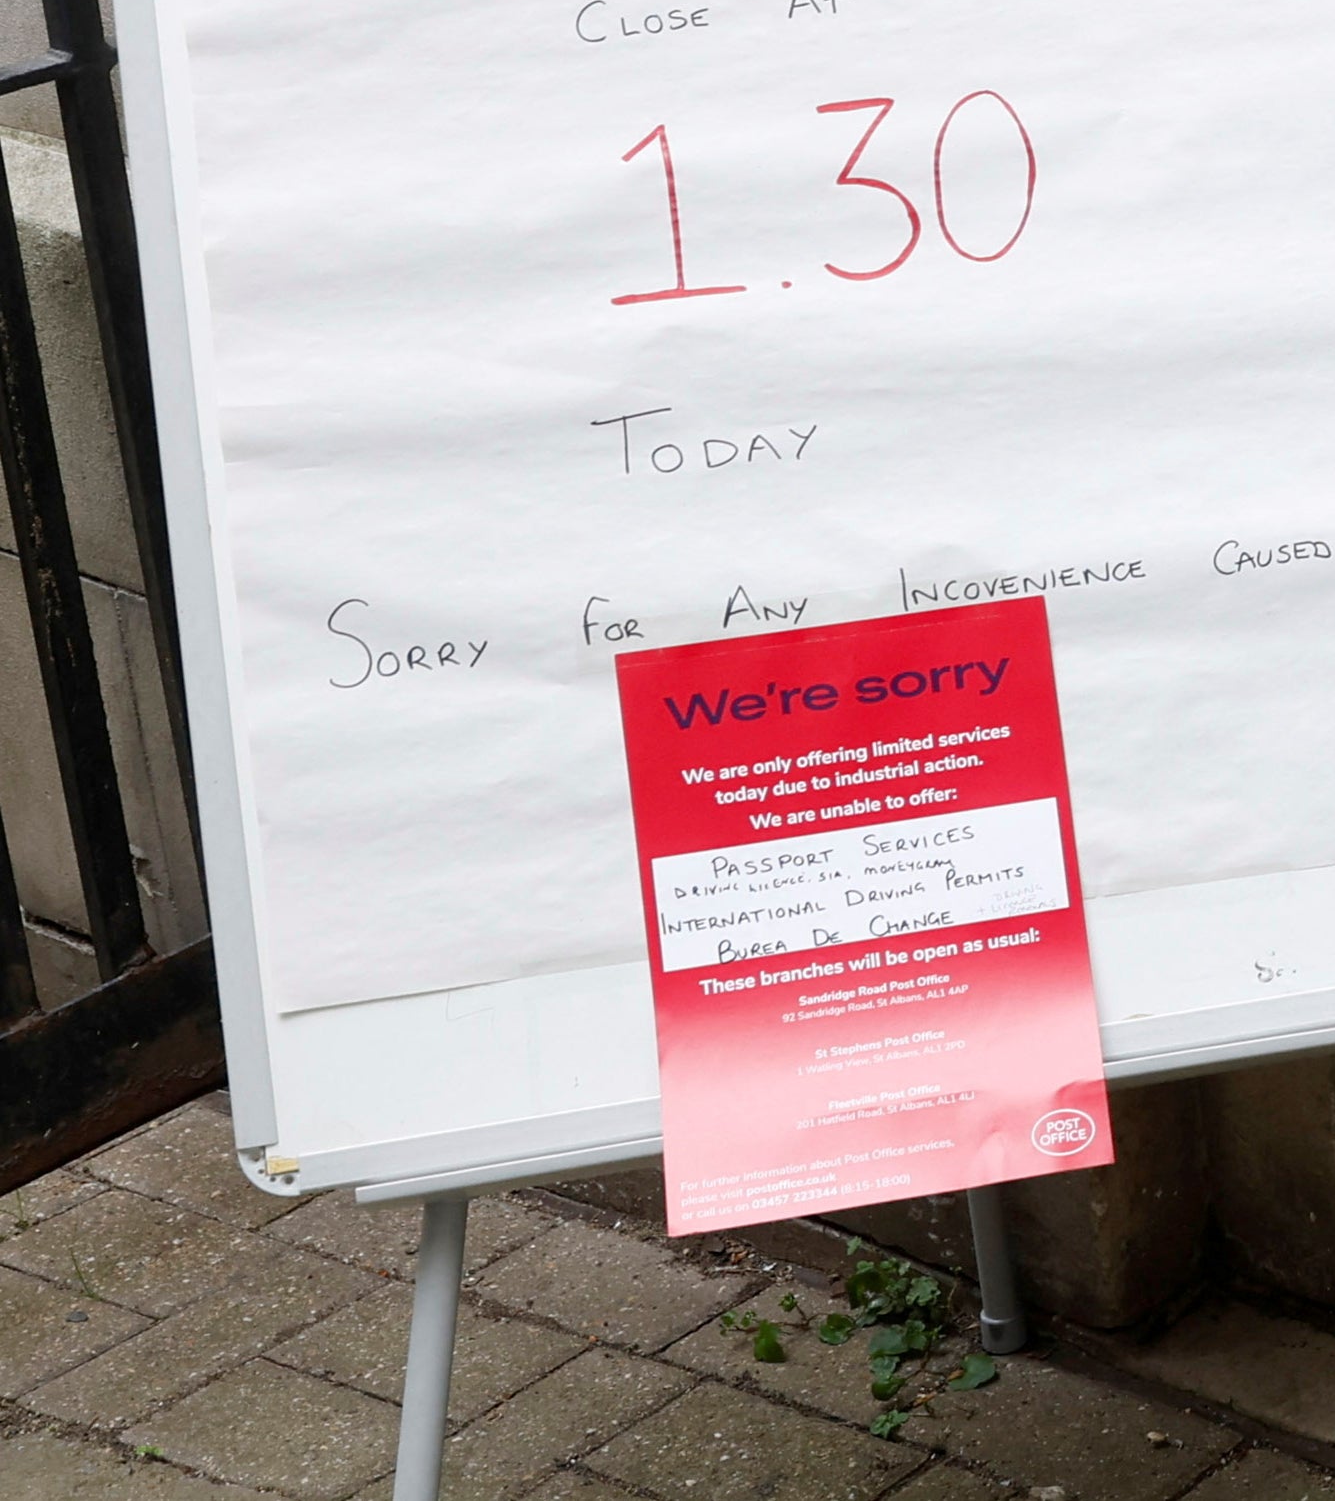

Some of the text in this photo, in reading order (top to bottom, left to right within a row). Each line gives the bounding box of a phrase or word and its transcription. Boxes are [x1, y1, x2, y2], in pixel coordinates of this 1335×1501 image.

[576, 0, 710, 43] CLOSE
[610, 89, 1037, 306] 1.30
[590, 406, 817, 474] TODAY
[327, 539, 1332, 689] SORRY FOR ANY INCOVENIENCE CAUSED
[665, 657, 1011, 730] We're sorry
[681, 725, 1010, 784] We are only offering limited services
[714, 754, 983, 804] today due to industrial action.
[748, 788, 957, 829] We are unable to offer:
[711, 825, 975, 879] PASSPORT SERVICES
[661, 865, 1025, 936] INTERNATIONAL DRIVING PERMITS
[698, 926, 1040, 995] These branches will be open as usual:
[717, 910, 954, 964] BUREA DE CHANGE
[782, 984, 968, 1022] 92 Sandridge Road, St Albans, AL1 4AP
[798, 975, 950, 1006] Sandridge Road Post Office
[815, 1030, 944, 1059] St Stephens Post Office
[828, 1084, 940, 1110] Fleetville Post Office
[1039, 1128, 1087, 1148] OFFICE
[1046, 1117, 1080, 1134] POST
